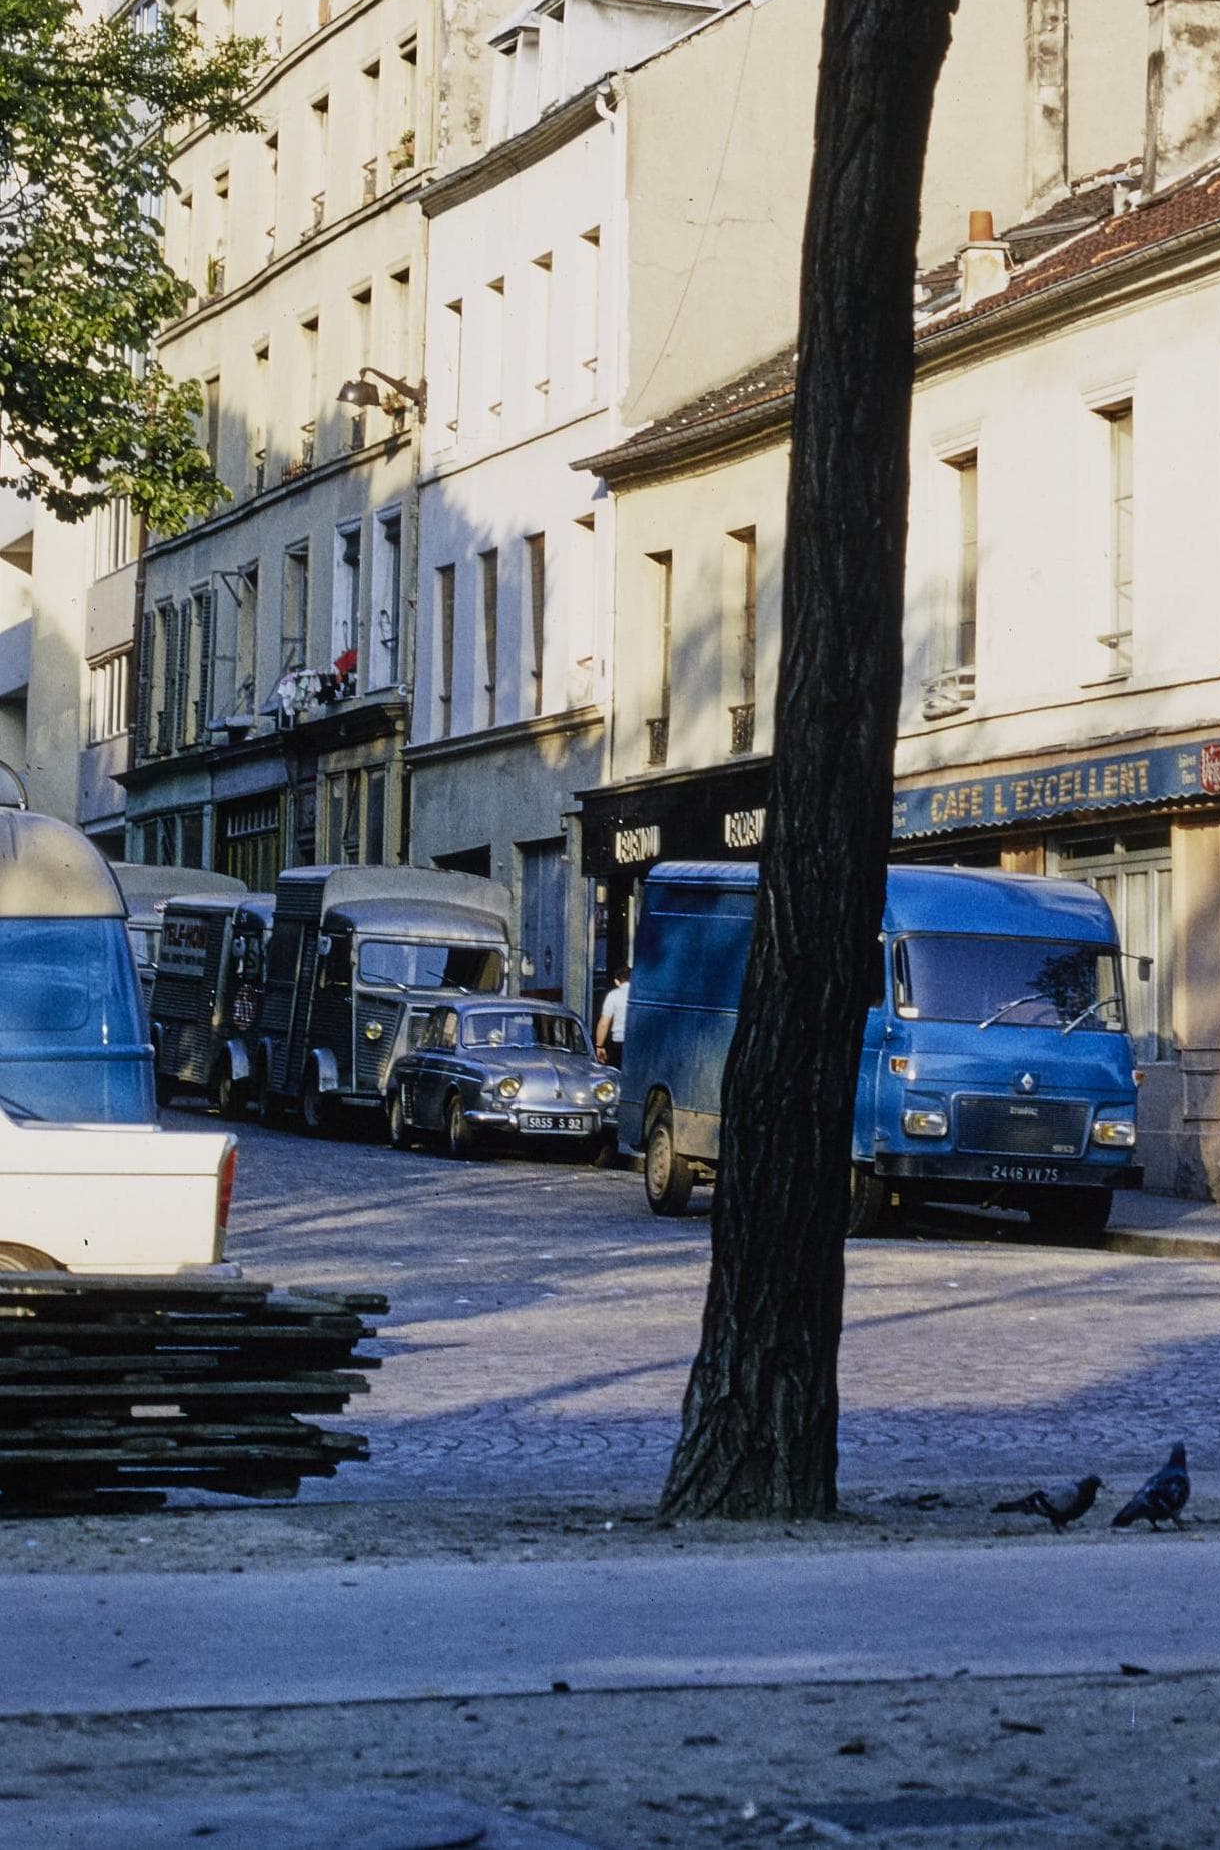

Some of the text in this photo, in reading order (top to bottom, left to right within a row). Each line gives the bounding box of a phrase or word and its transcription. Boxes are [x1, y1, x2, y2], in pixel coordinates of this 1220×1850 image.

[994, 759, 1150, 816] L'EXCELLENT
[558, 1118, 566, 1129] S
[568, 1118, 582, 1130] 92
[1044, 1168, 1059, 1182] 75
